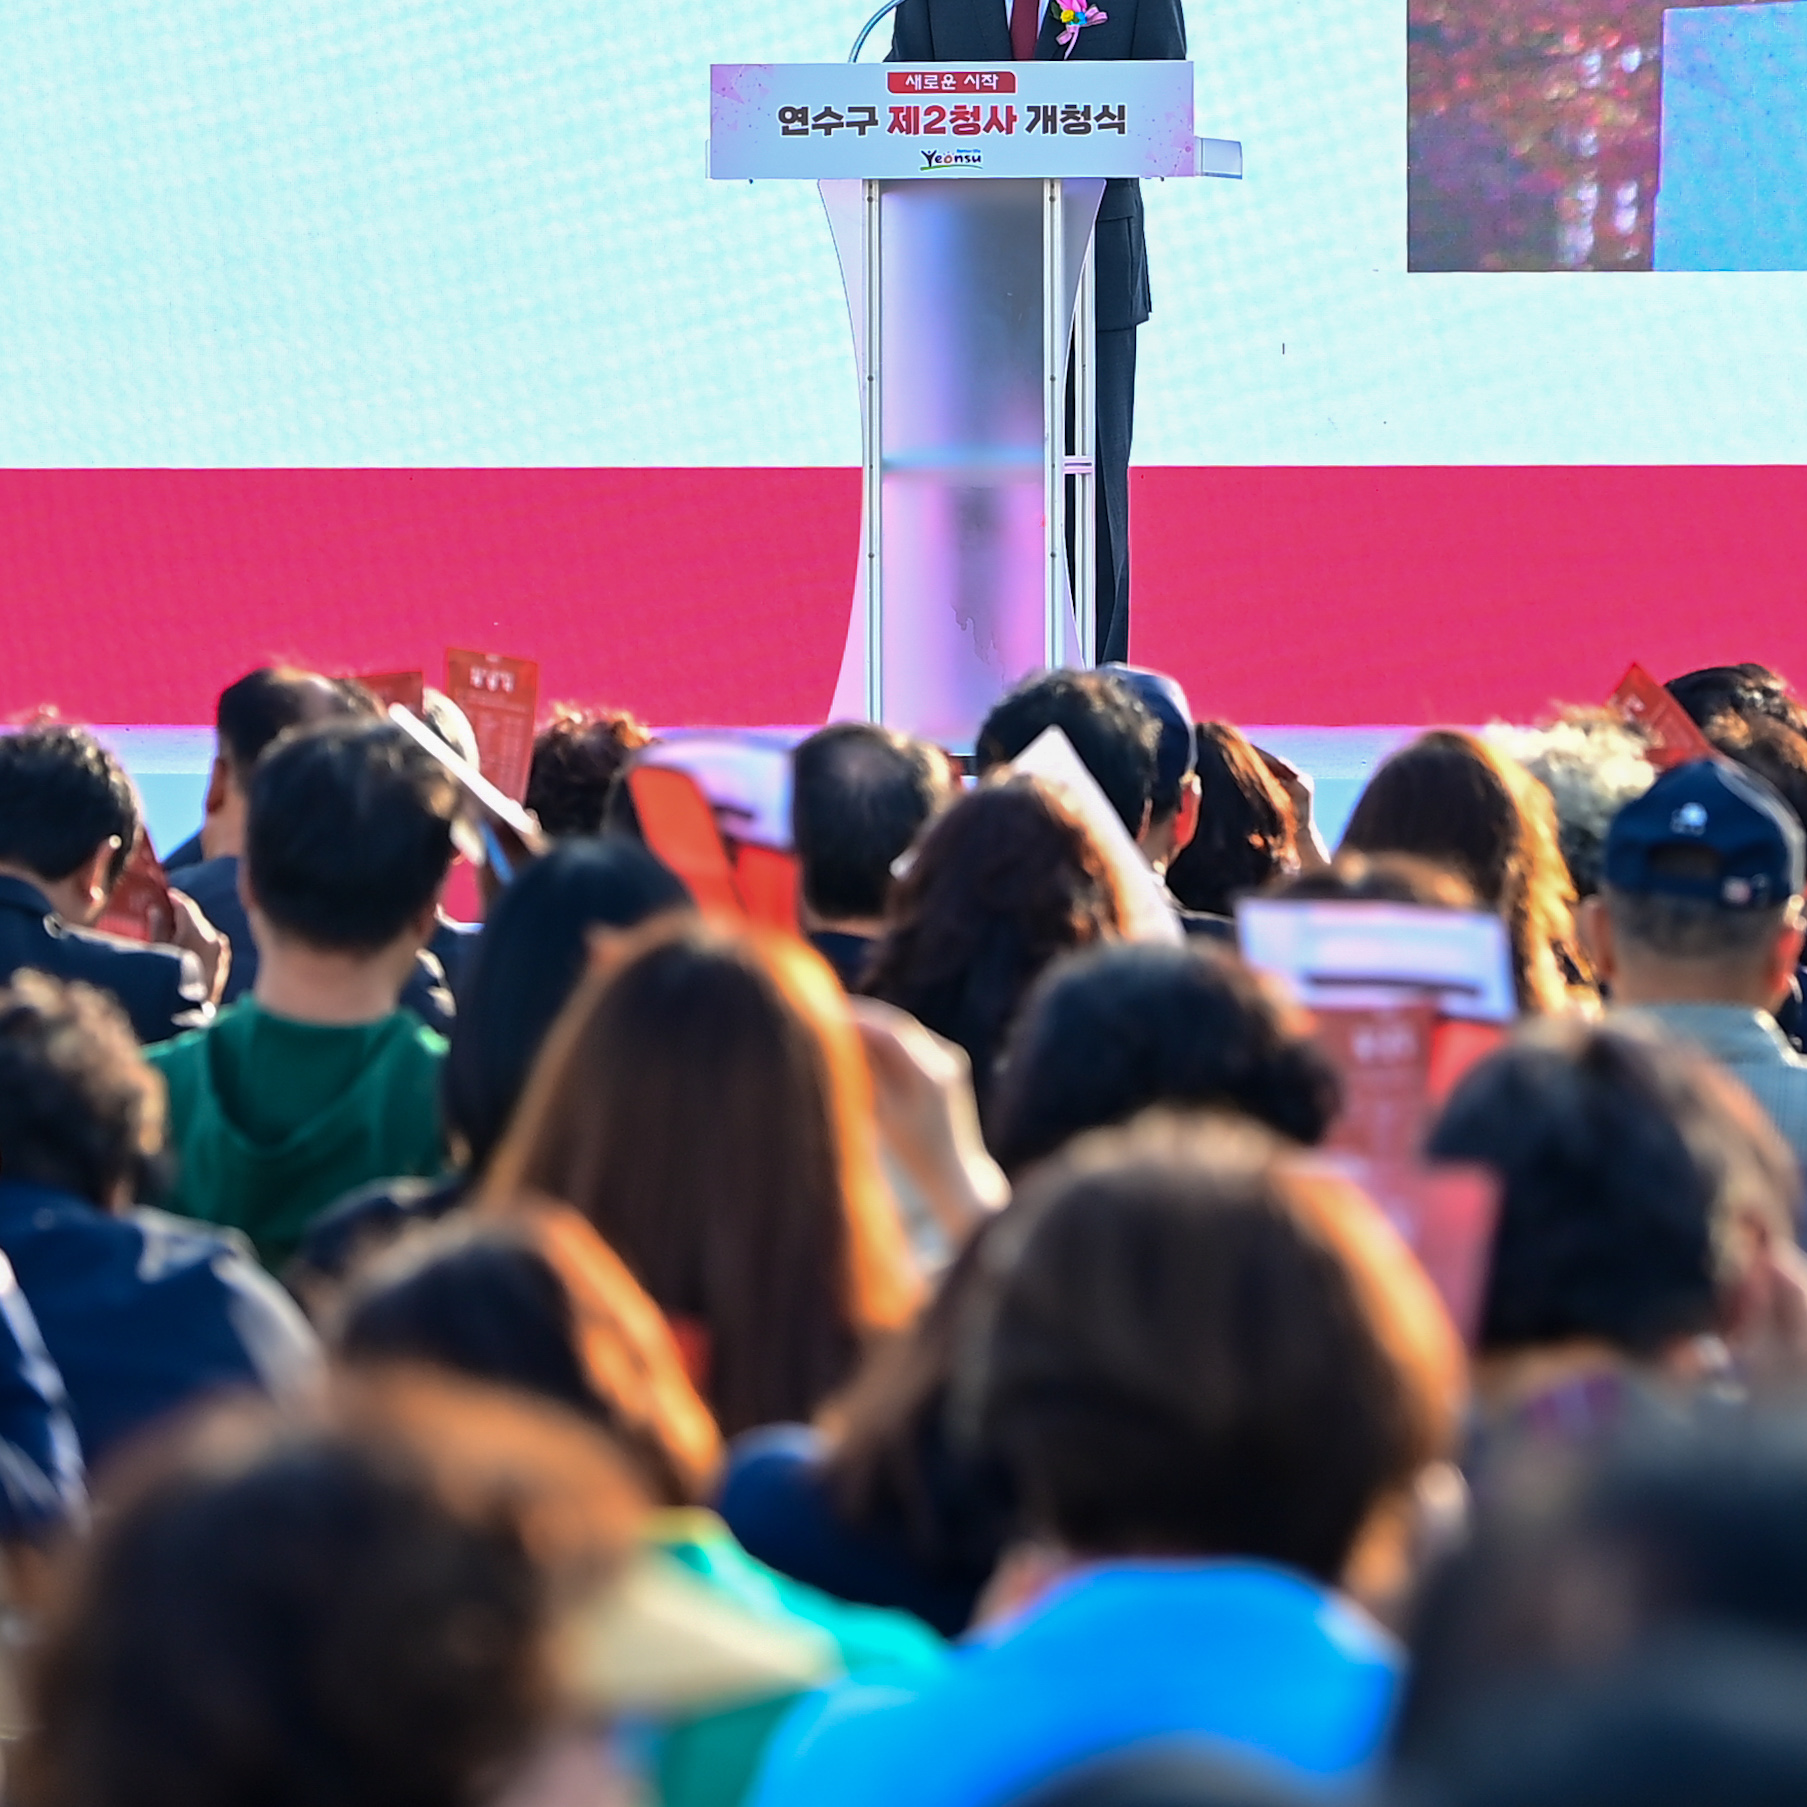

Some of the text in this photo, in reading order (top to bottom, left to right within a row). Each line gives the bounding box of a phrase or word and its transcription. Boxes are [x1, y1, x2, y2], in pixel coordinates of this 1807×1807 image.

[905, 73, 999, 91] 새로운 시작
[777, 104, 1127, 136] 연수구 제2청사 개청식
[920, 149, 981, 167] Yeonsu
